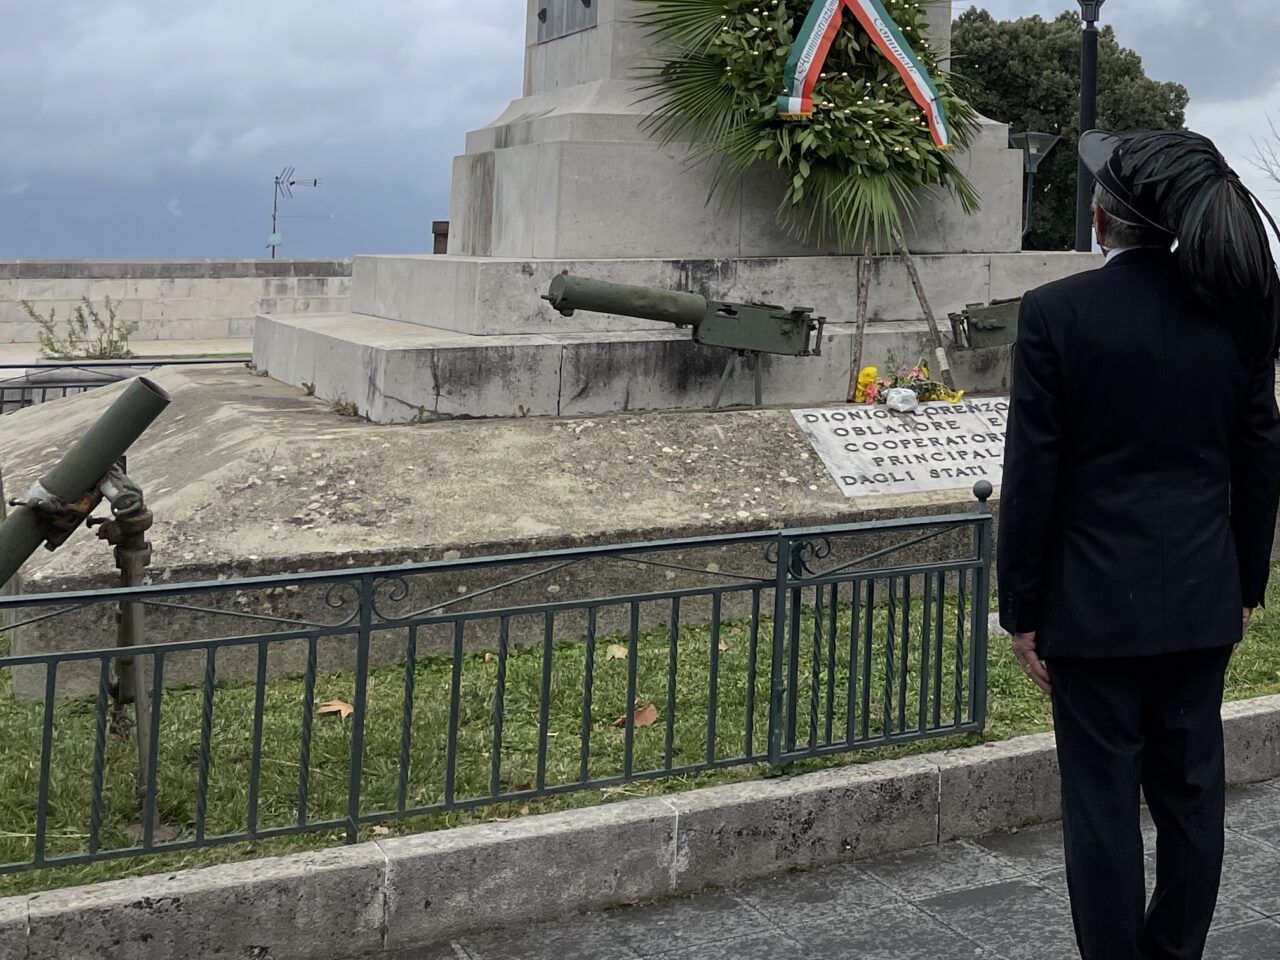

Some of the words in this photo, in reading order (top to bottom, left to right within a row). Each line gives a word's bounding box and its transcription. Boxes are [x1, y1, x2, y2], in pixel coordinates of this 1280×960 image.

[874, 17, 917, 75] Comunale
[833, 420, 960, 436] OBLATORE
[987, 417, 1003, 427] E
[871, 448, 1002, 467] PRINCIPAL
[840, 471, 916, 486] DAGLI
[929, 465, 988, 479] STATI
